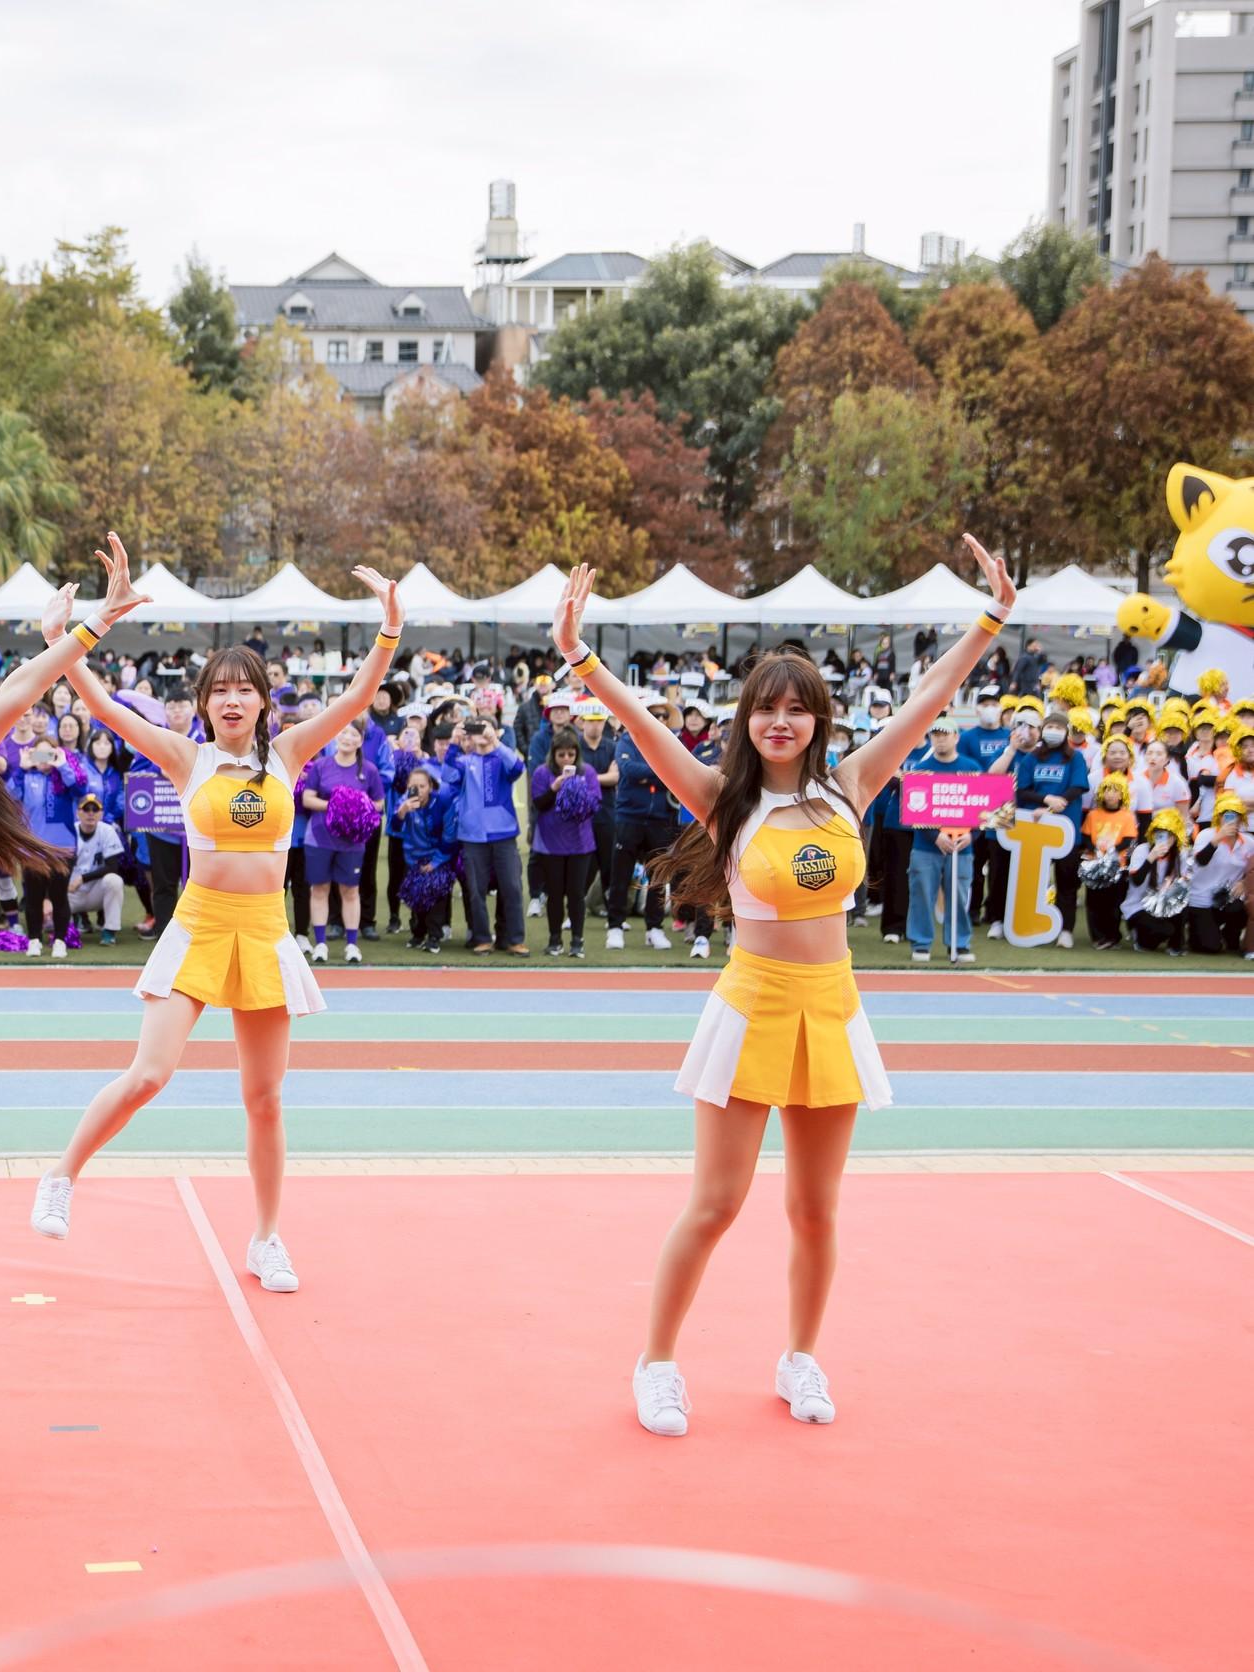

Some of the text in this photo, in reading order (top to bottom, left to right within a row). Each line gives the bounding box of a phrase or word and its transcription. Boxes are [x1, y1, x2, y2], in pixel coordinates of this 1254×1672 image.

[154, 787, 176, 795] HIGH
[932, 783, 968, 794] EDEN
[932, 795, 990, 806] ENGLISH
[229, 801, 266, 813] PASSION
[792, 856, 836, 875] PASSION
[803, 872, 828, 882] SISTERS
